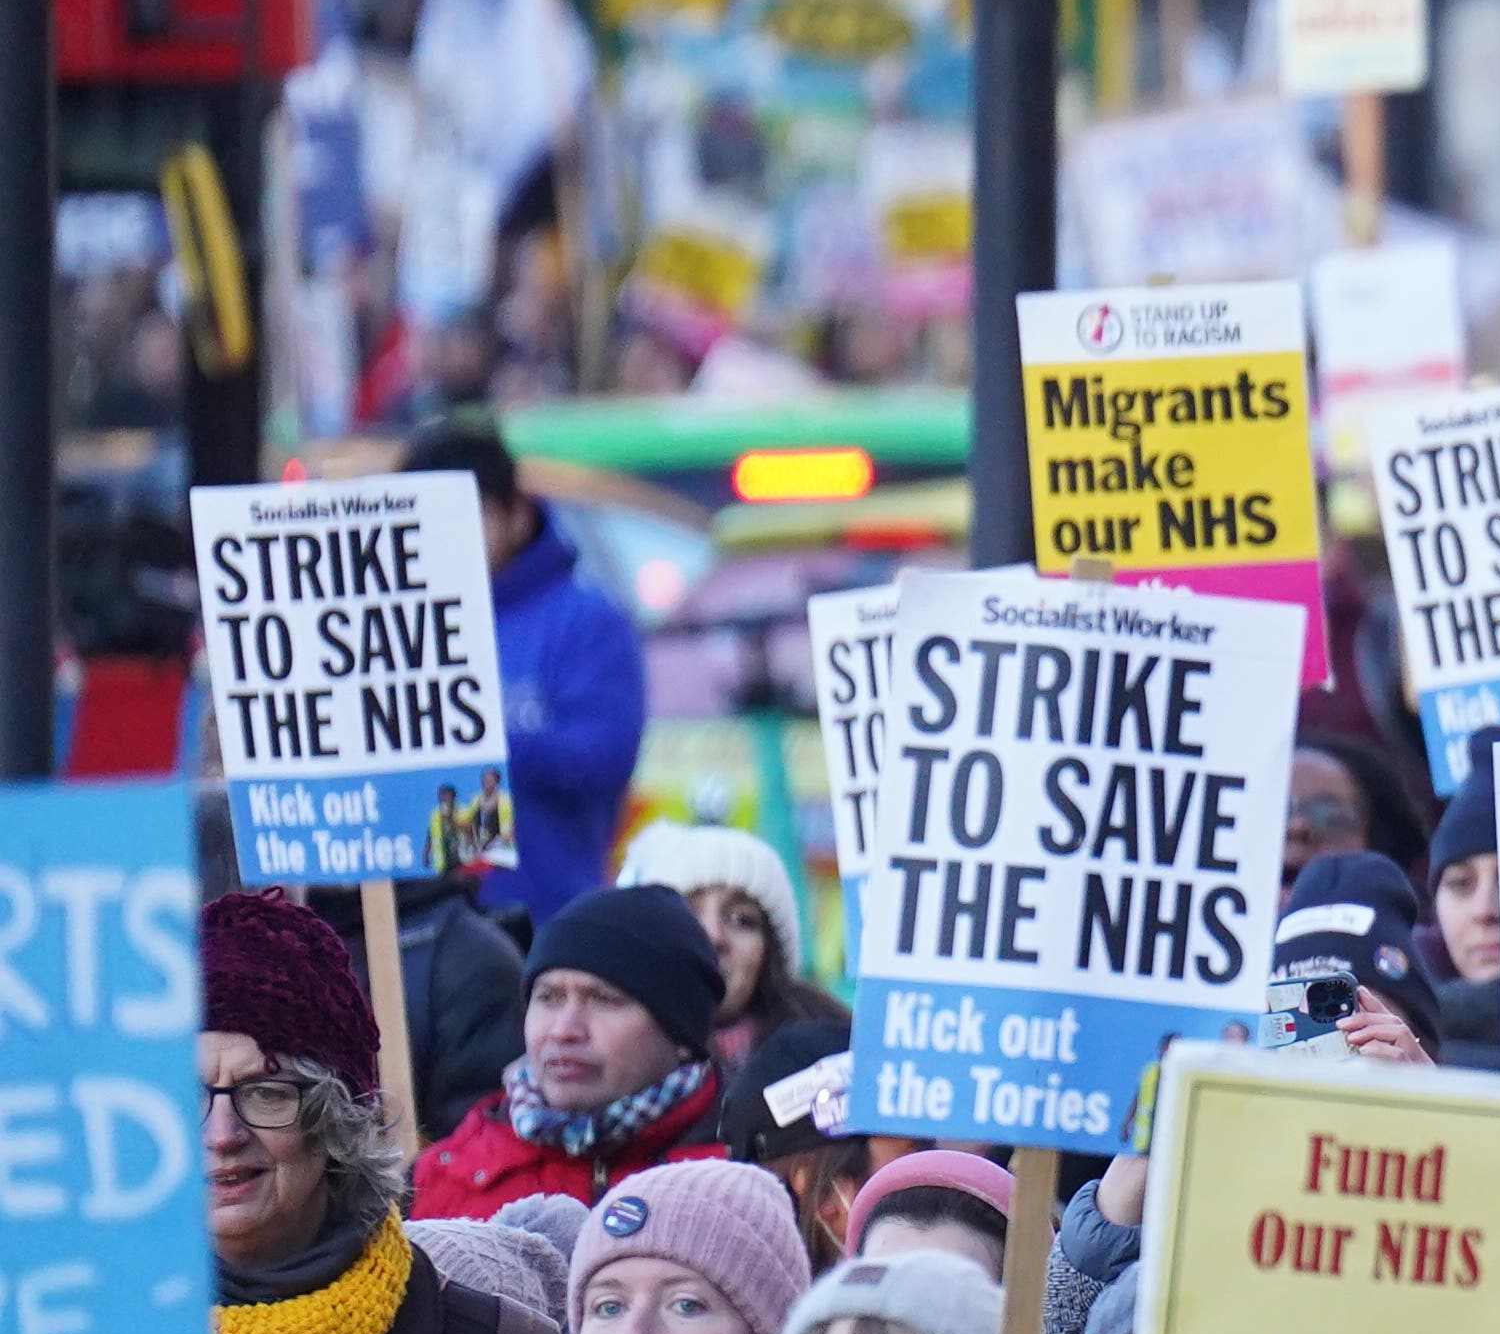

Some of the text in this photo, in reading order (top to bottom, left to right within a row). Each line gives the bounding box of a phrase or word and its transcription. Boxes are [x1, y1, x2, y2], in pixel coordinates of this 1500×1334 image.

[1200, 300, 1229, 321] UP
[1041, 369, 1290, 441] Migrants
[1049, 440, 1196, 496] make
[340, 491, 418, 517] Worker
[1052, 493, 1278, 556] our NHS
[1400, 523, 1468, 593] TO
[219, 614, 293, 682] TO
[982, 596, 1216, 646] Socialist Worker
[229, 690, 339, 760] THE
[250, 784, 380, 827] Kick out
[255, 827, 414, 876] the Tories
[884, 991, 1080, 1064] Kick out
[878, 1066, 1111, 1134] the Tories
[1303, 1132, 1446, 1205] Fund
[1249, 1211, 1484, 1289] Our NHS
